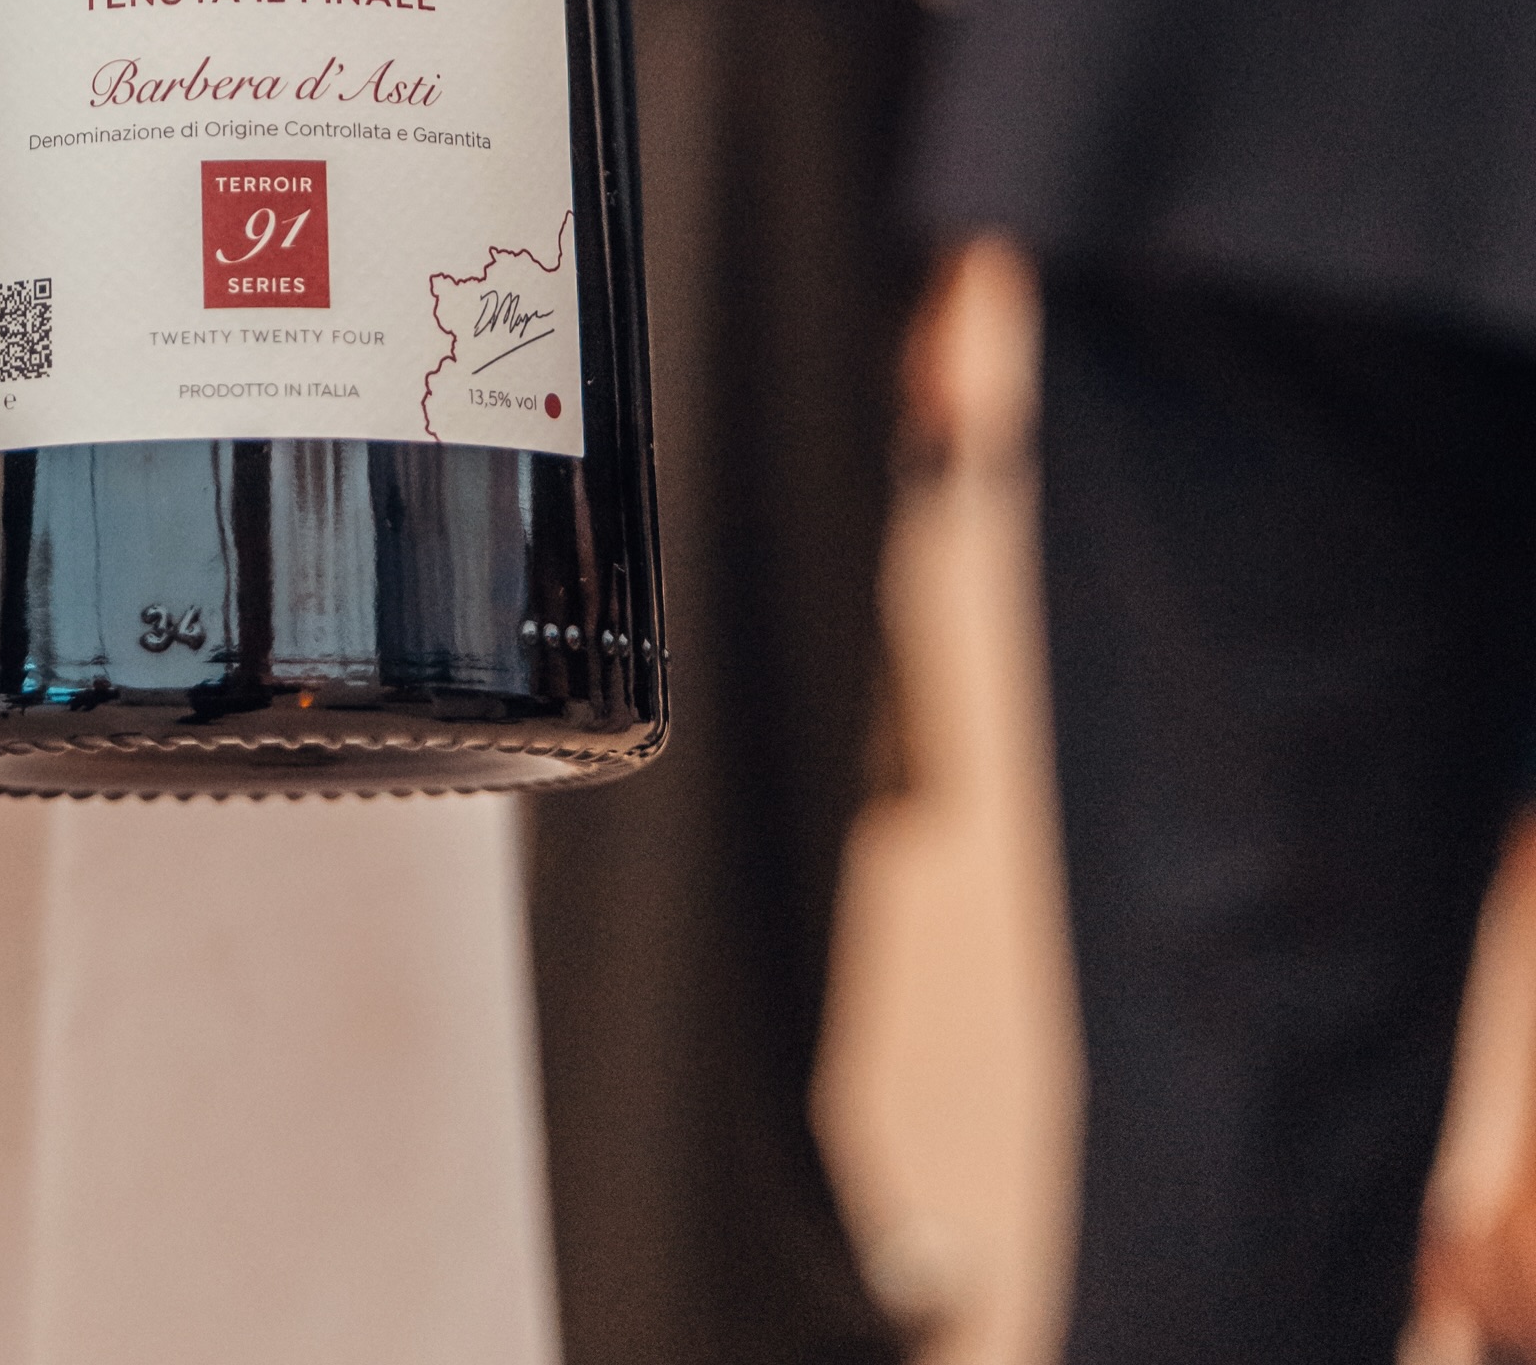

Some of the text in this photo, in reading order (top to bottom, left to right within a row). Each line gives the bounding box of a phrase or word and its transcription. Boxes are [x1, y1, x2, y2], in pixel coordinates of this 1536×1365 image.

[90, 56, 288, 108] Barbera
[29, 120, 491, 150] Denominazione di Origine Controllata e Garantita
[216, 177, 312, 192] TERROIR
[216, 208, 310, 264] 91
[228, 278, 305, 293] SERIES
[150, 329, 384, 345] TWENTY TWENTY FOUR
[180, 383, 360, 398] PRODOTTO IN ITALIA
[469, 389, 537, 410] 13,5% vol
